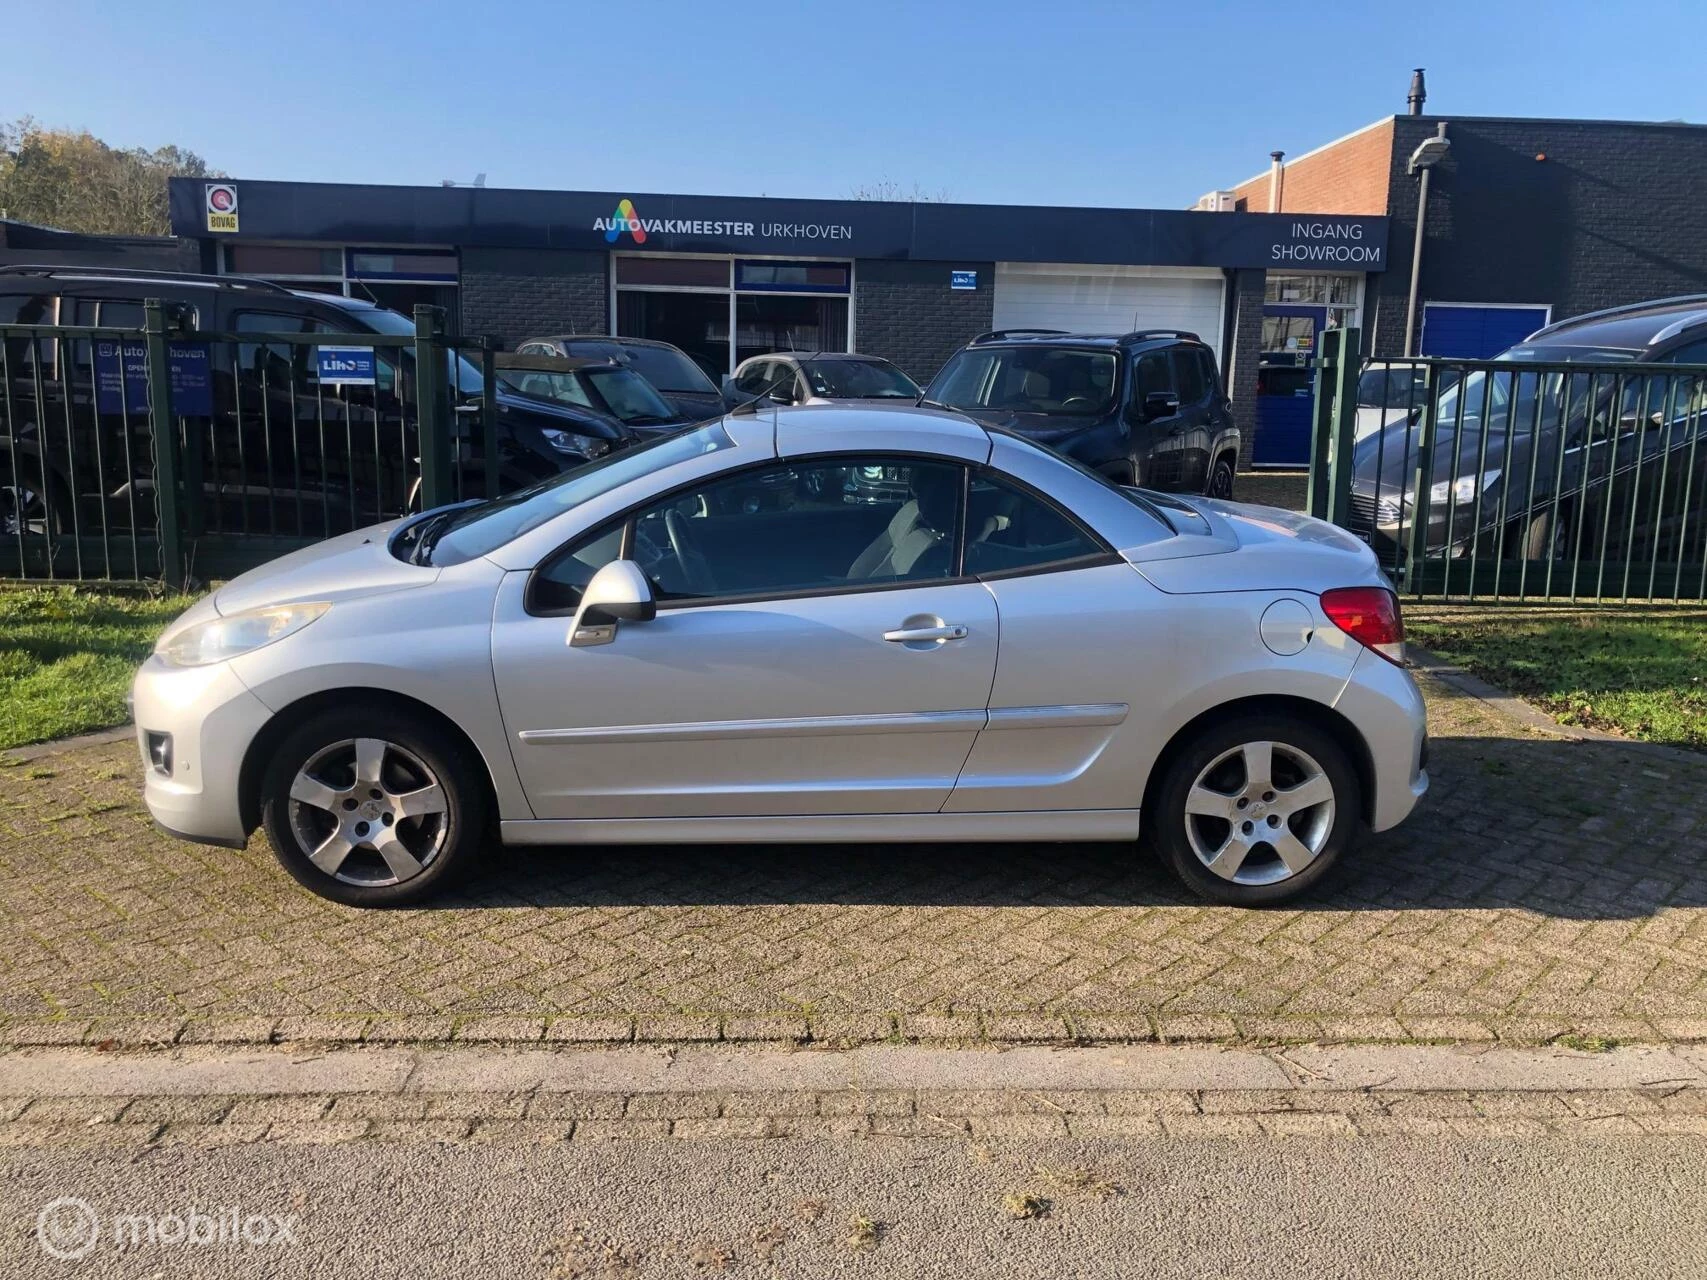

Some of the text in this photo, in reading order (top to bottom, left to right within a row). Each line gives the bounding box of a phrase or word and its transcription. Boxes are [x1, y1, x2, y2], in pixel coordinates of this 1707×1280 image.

[211, 216, 236, 228] BOVAG
[593, 217, 852, 240] AUTOVAKMEESTER URKHOVEN
[1292, 223, 1363, 240] INGANG
[1271, 244, 1381, 262] SHOWROOM
